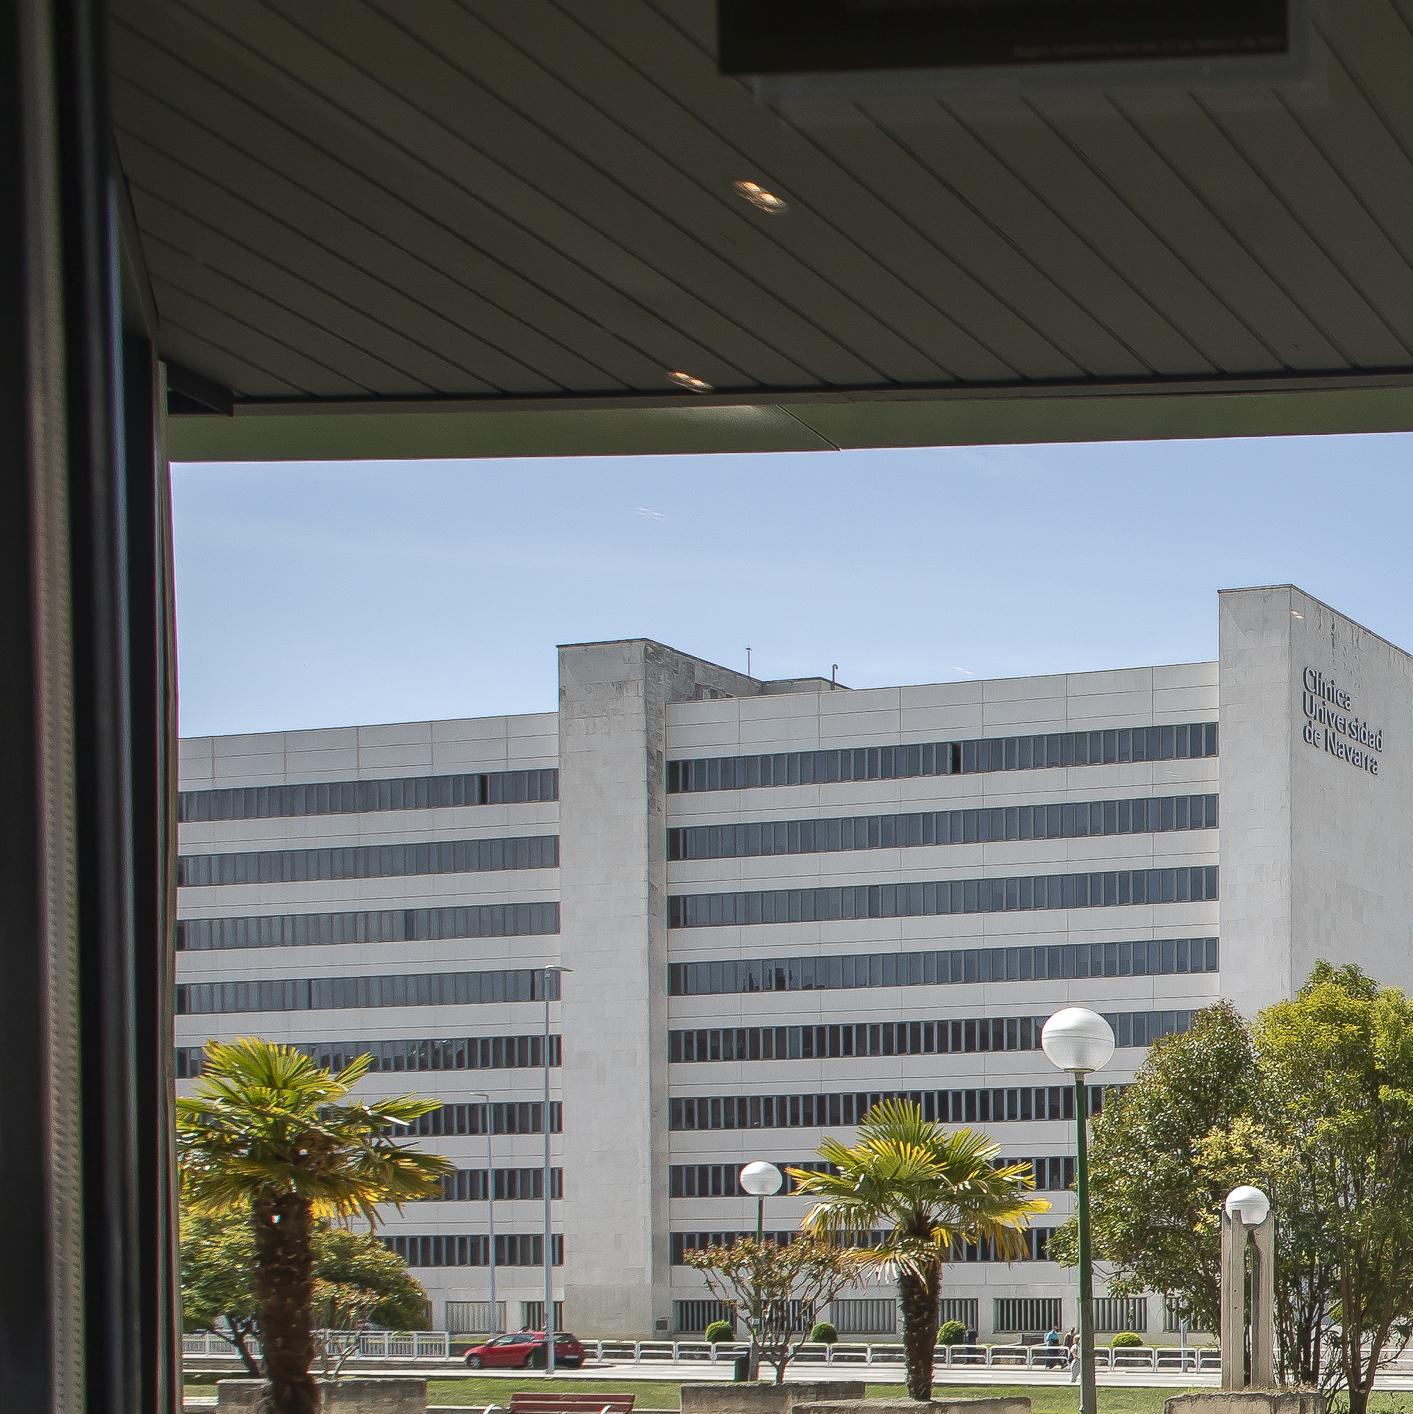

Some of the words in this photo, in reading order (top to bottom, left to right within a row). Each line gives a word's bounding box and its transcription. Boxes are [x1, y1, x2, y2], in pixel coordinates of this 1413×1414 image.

[1303, 691, 1383, 753] Universidad
[1303, 720, 1321, 748] de
[1325, 728, 1378, 775] Navarra
